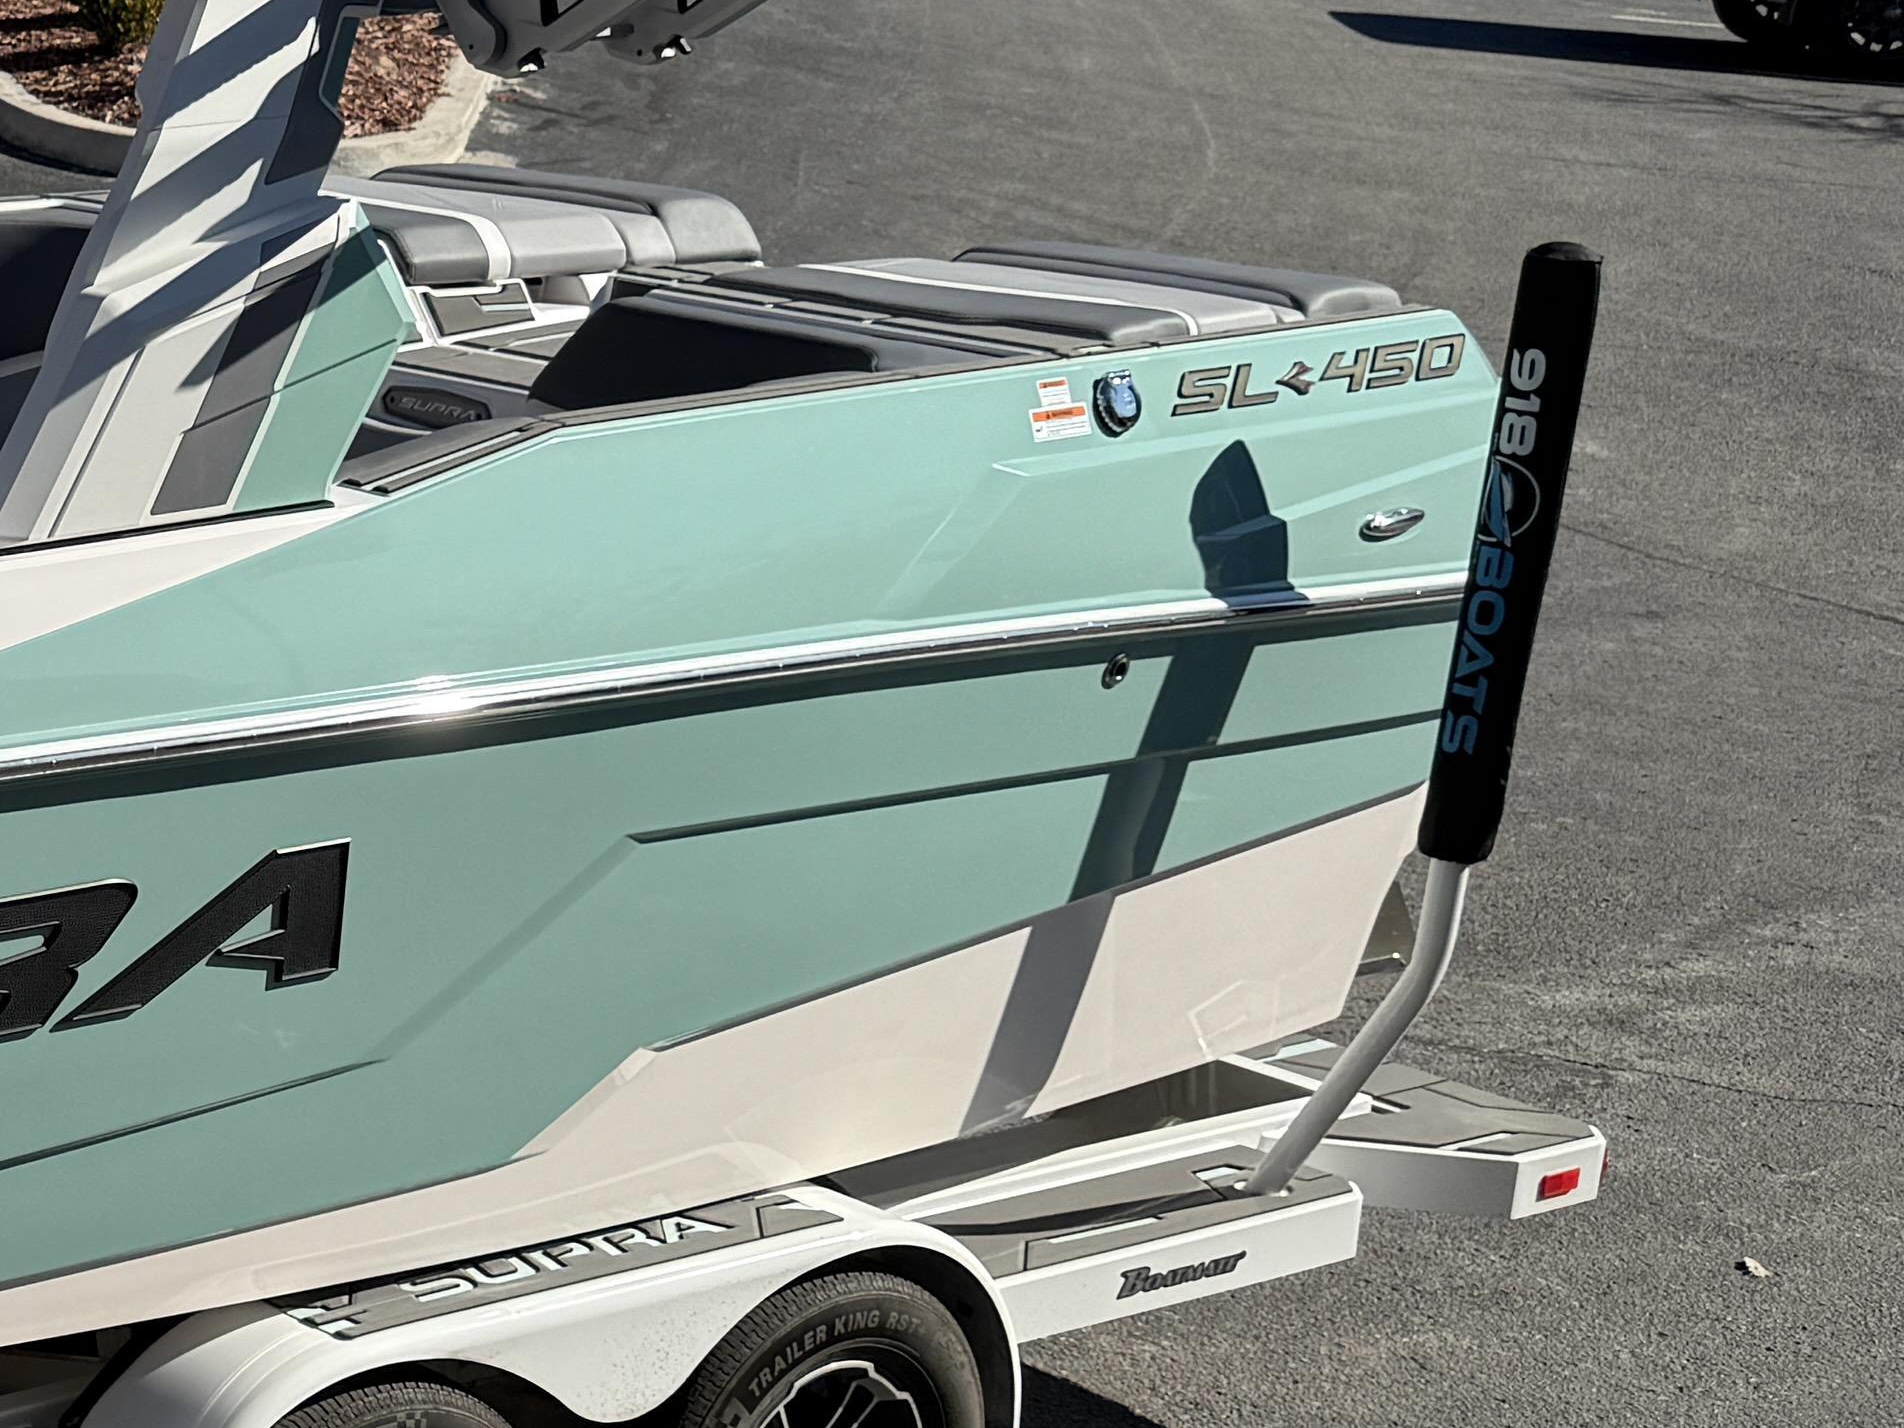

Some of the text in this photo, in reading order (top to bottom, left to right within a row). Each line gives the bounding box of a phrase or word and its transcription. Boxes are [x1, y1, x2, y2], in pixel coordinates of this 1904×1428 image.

[399, 396, 476, 421] SUPRA
[1171, 333, 1466, 417] SL 450
[1442, 348, 1546, 755] 918 BOATS
[397, 1215, 734, 1303] SUPRA
[747, 1324, 828, 1398] TRAILER
[834, 1309, 881, 1337] KING
